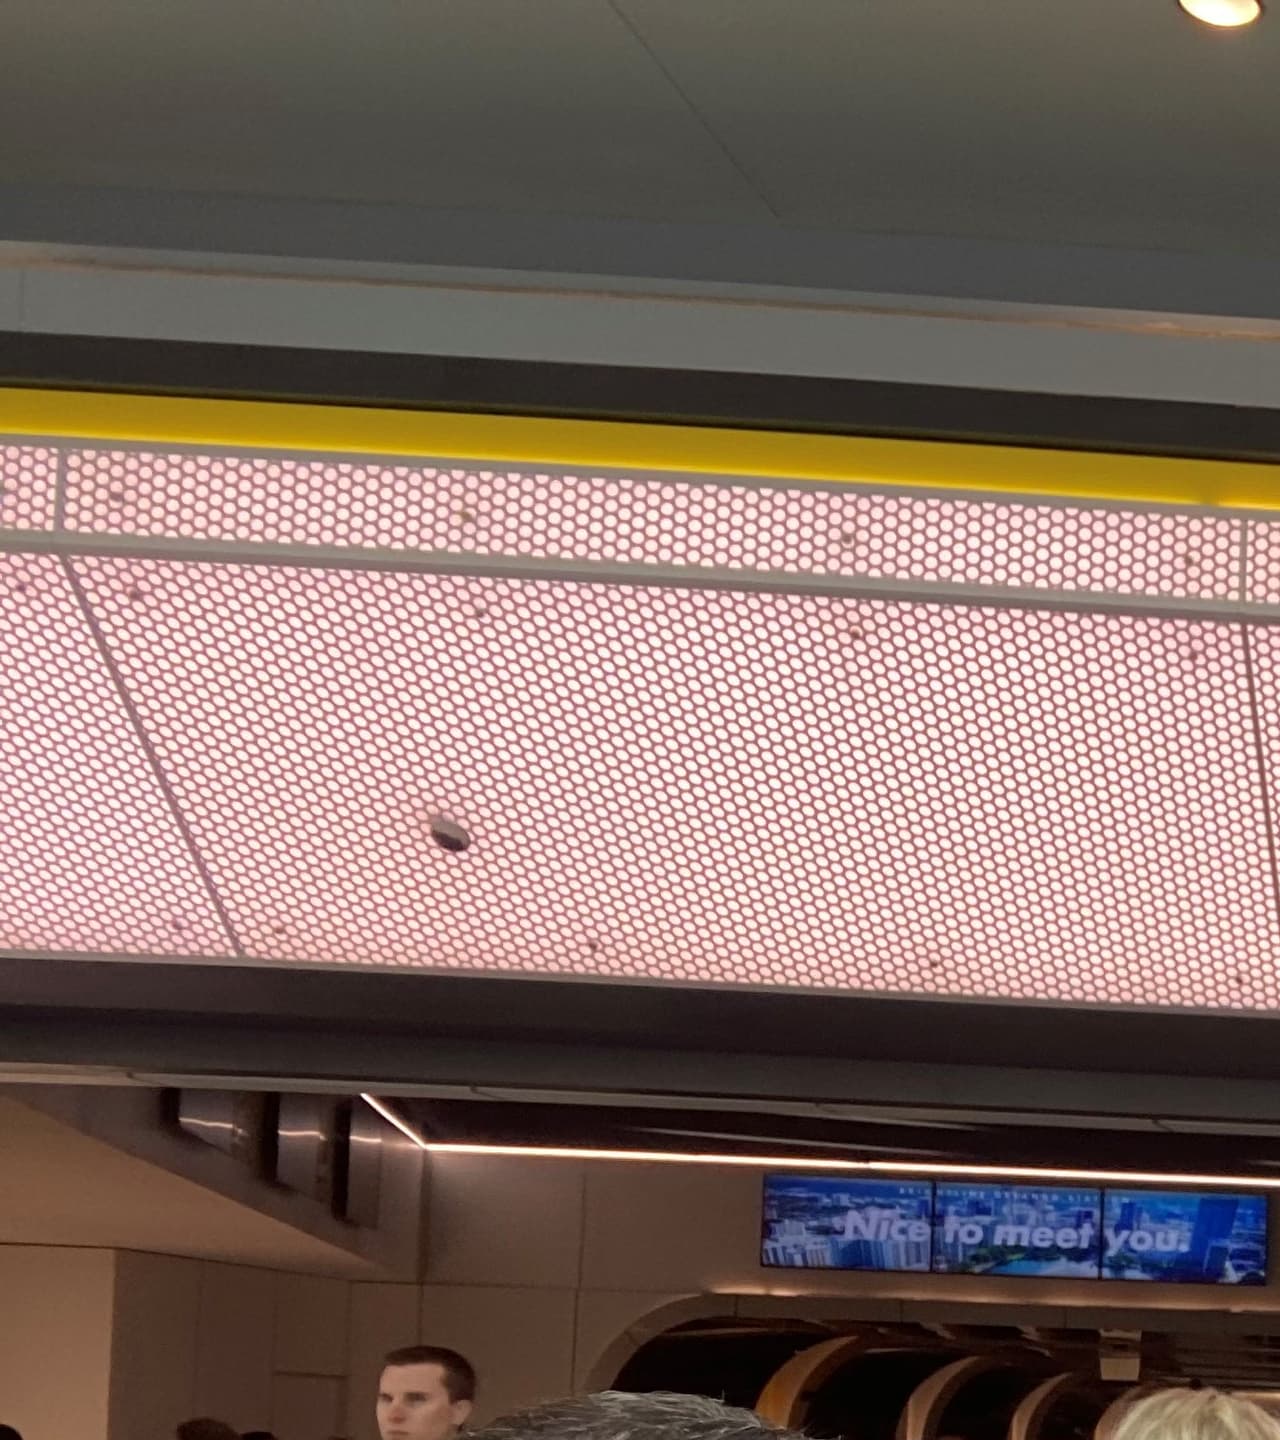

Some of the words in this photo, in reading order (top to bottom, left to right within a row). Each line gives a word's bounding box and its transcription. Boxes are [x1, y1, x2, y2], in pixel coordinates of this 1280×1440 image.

[841, 1208, 931, 1243] Nice
[945, 1216, 983, 1246] to
[993, 1220, 1094, 1250] meet
[1103, 1230, 1191, 1254] you.
